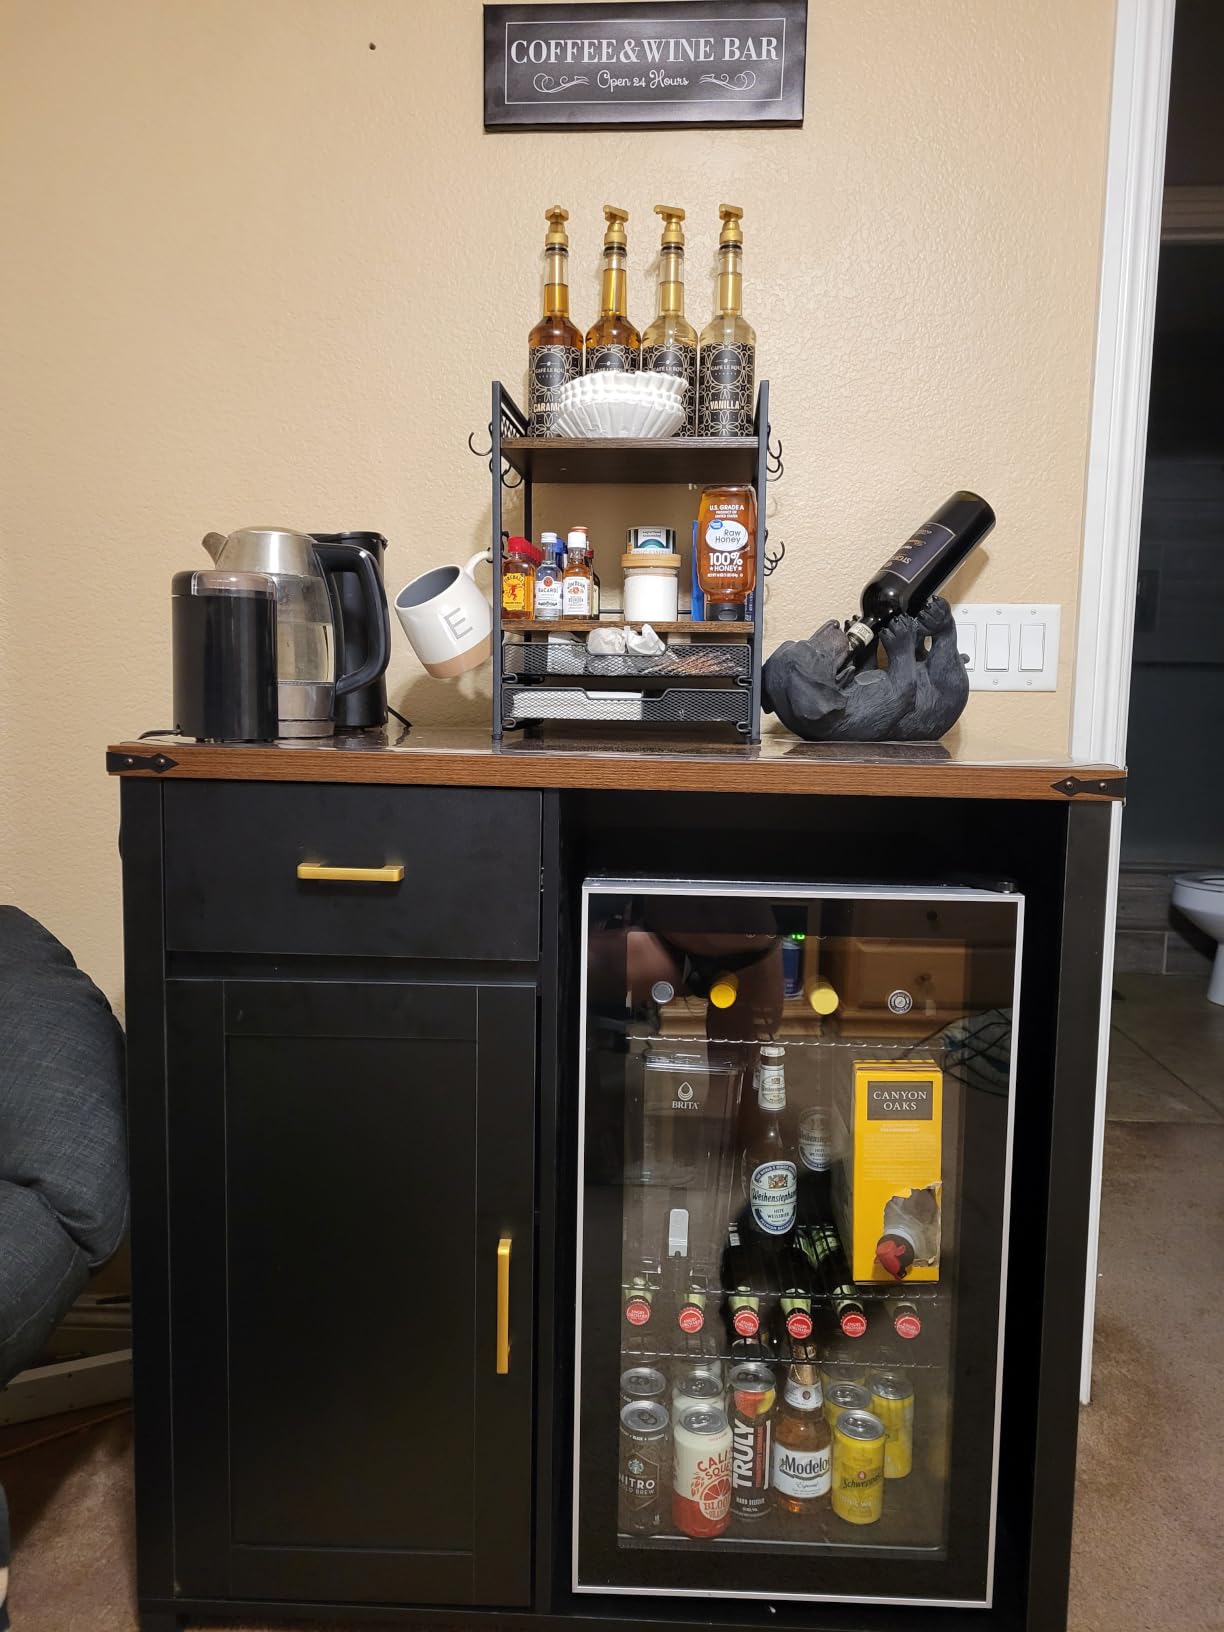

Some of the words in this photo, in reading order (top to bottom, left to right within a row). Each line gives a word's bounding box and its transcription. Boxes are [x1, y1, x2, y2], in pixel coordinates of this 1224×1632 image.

[510, 37, 715, 64] COFFEE&WINE
[722, 36, 780, 62] BAR
[597, 70, 631, 93] Open
[632, 77, 646, 88] 24
[649, 69, 690, 89] Hours
[710, 400, 740, 410] VANILLA
[715, 536, 741, 544] Honey
[724, 529, 741, 537] Raw
[709, 552, 743, 566] 100%
[443, 607, 473, 640] E
[873, 1091, 927, 1100] CANYON
[672, 1100, 698, 1110] BRITA
[883, 1102, 917, 1111] OAKS
[733, 1418, 754, 1488] TRULY
[697, 1450, 728, 1473] CALI
[785, 1454, 828, 1475] Modelo
[618, 1472, 656, 1489] NITRO
